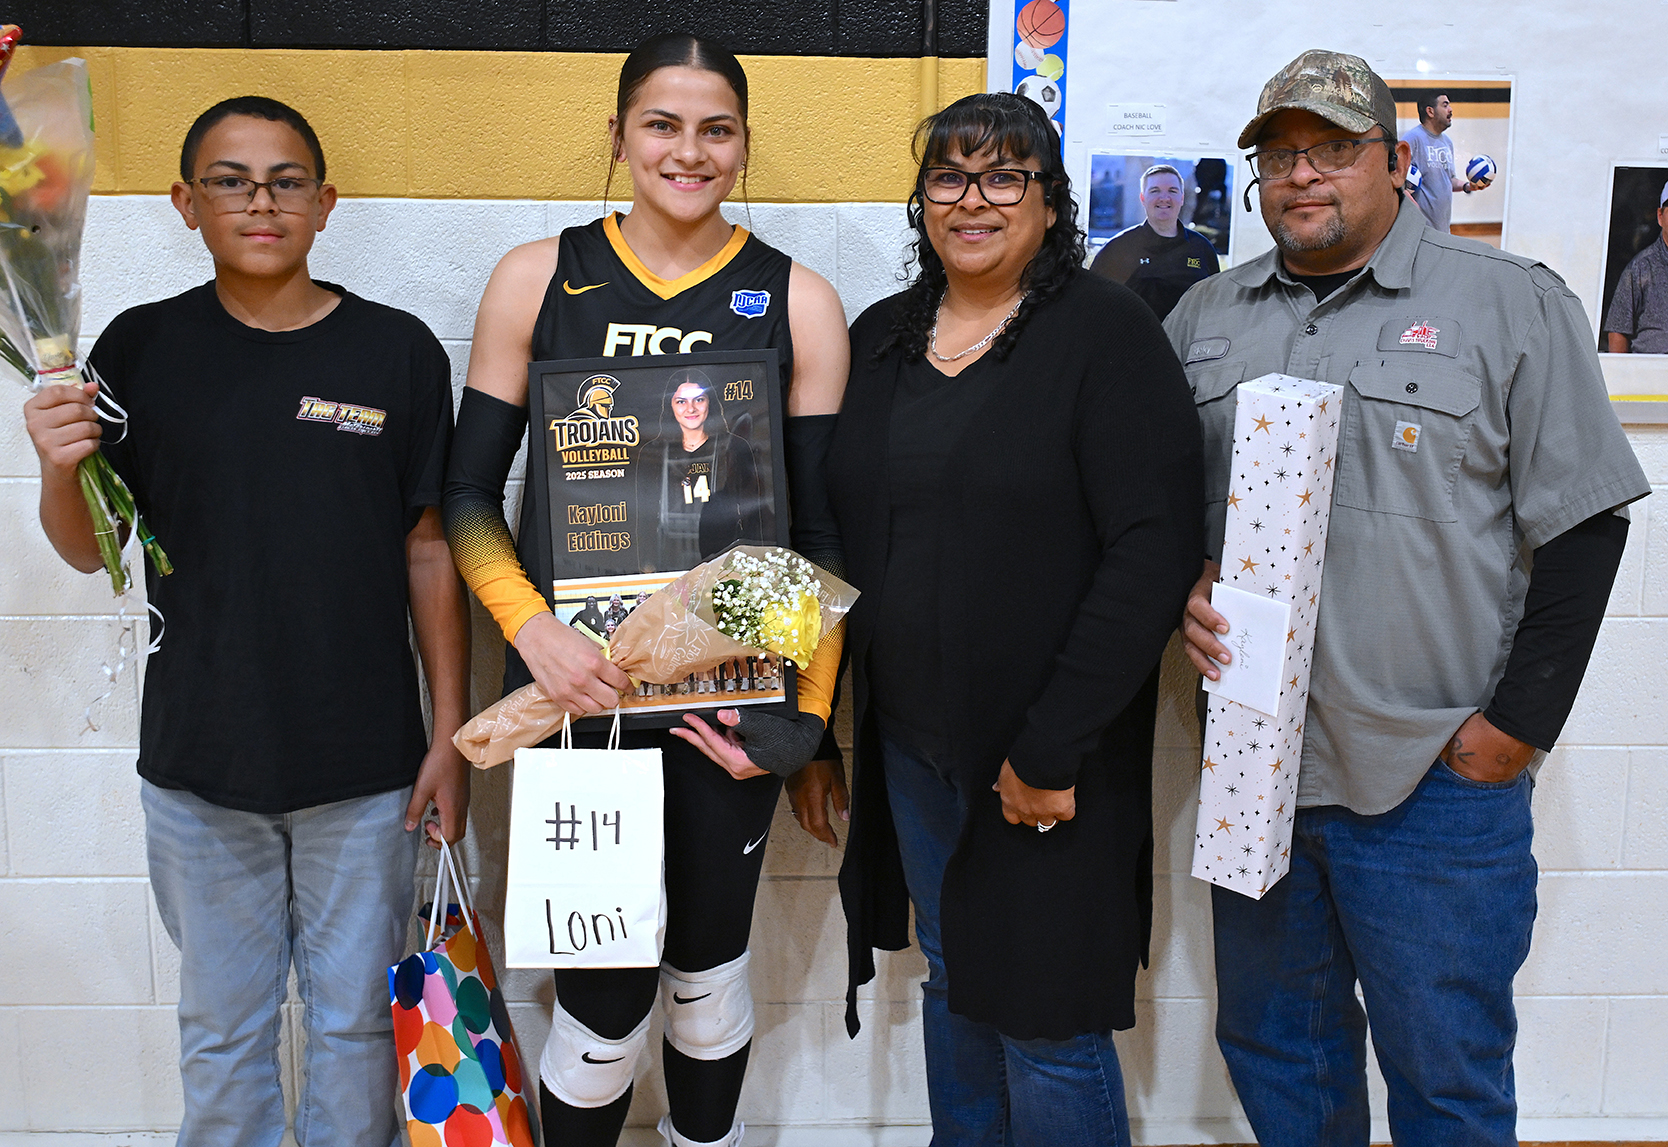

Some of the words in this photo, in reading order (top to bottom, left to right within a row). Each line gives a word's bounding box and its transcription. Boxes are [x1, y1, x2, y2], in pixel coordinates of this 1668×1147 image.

[602, 322, 713, 357] FTCC
[592, 377, 612, 385] FTCC
[724, 380, 754, 401] #14
[298, 397, 338, 421] TAG
[336, 403, 387, 429] TEAM
[551, 418, 639, 449] TROJANS
[561, 447, 630, 464] VOLLEYBALL
[565, 470, 587, 480] 2025
[588, 468, 625, 480] SEASON
[683, 475, 711, 505] 14
[567, 501, 627, 526] Kayloni
[567, 530, 632, 553] Eddings
[545, 802, 620, 851] #14
[545, 899, 628, 956] Loni
